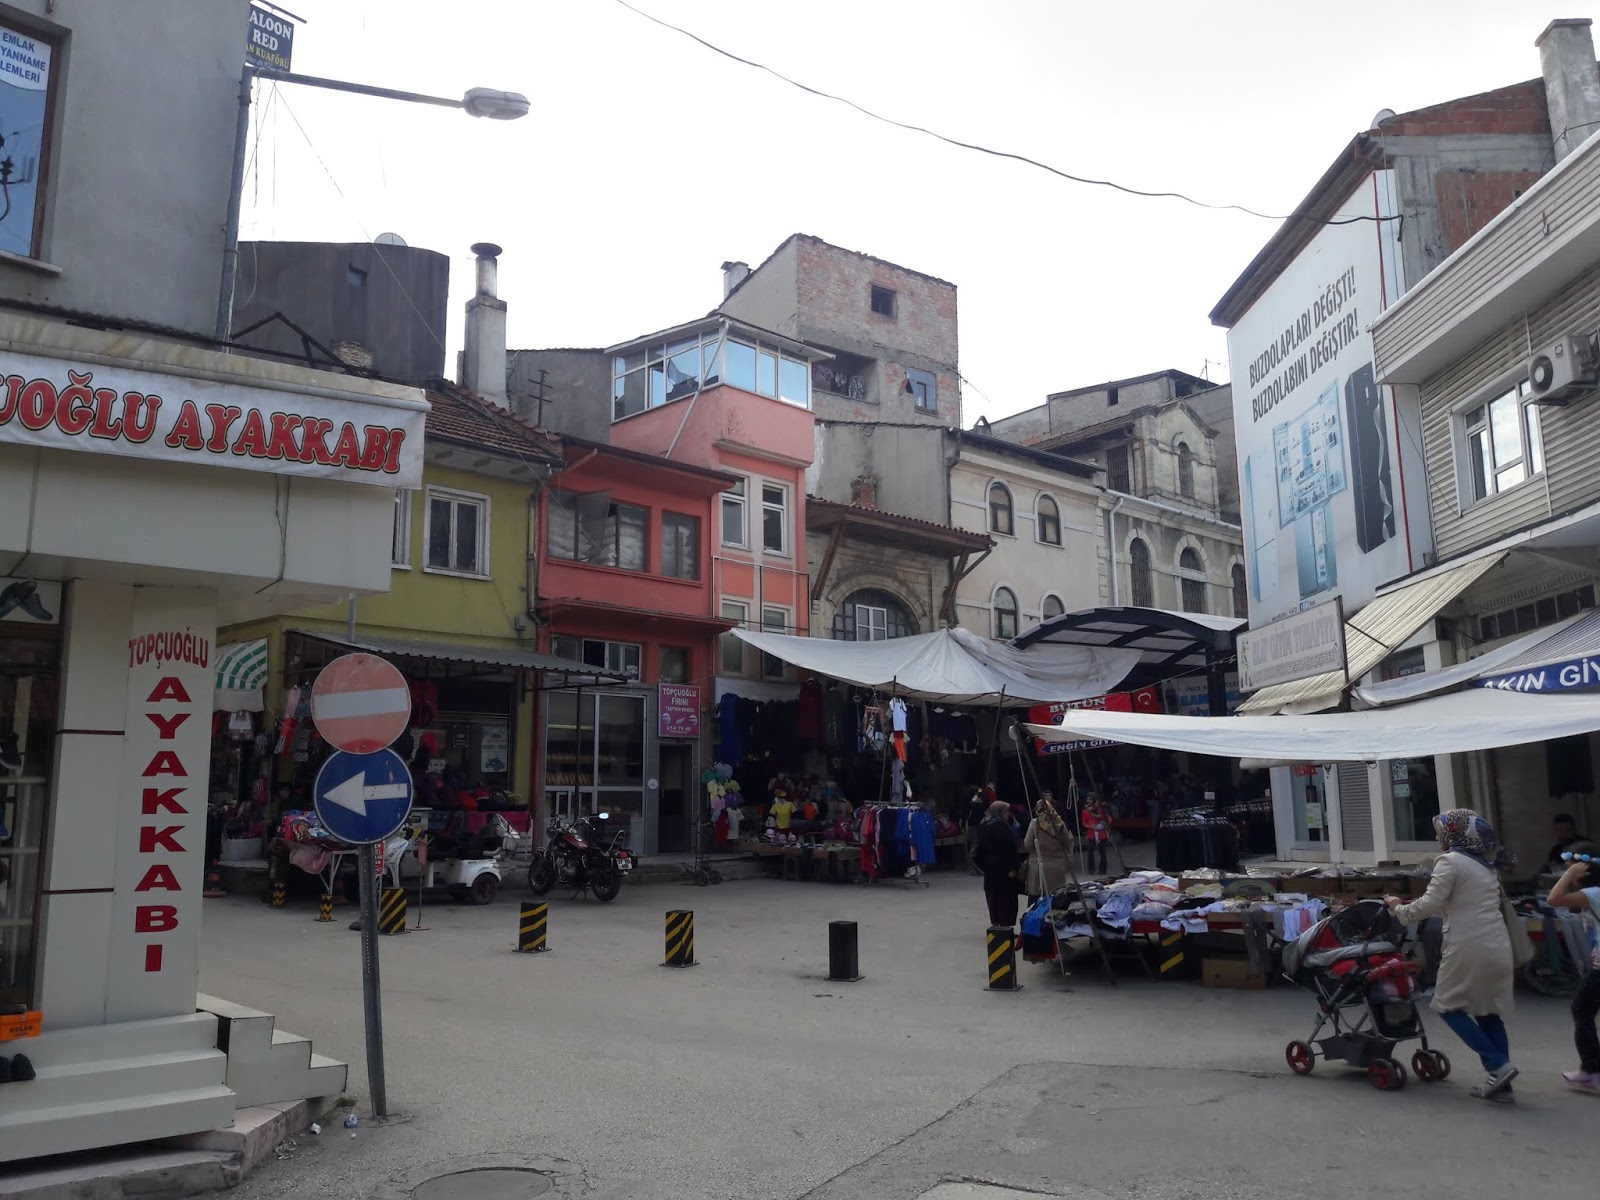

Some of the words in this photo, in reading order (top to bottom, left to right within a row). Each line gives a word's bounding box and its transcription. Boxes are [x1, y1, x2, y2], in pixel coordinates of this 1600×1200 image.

[2, 32, 35, 53] EMLAK
[252, 28, 279, 51] RED
[1, 45, 46, 71] YANNAME
[255, 47, 290, 69] KUAFÖRÜ
[0, 60, 40, 83] LEMLERİ
[1249, 308, 1312, 389] BUZDOLAPLARI
[1313, 265, 1357, 329] DEĞİŞTİ!
[1252, 352, 1309, 423] BUZDOLABINI
[1310, 307, 1359, 375] DEĞİŞTİR!
[165, 399, 406, 474] AYAKKABI
[128, 625, 209, 669] TOPÇUOĞLU
[663, 687, 697, 698] TOPÇUOĞLU
[671, 697, 689, 706] FIRINI
[1049, 697, 1106, 713] BÜTÜN
[1049, 741, 1087, 752] ENGİN
[134, 676, 192, 972] AYAKKABI
